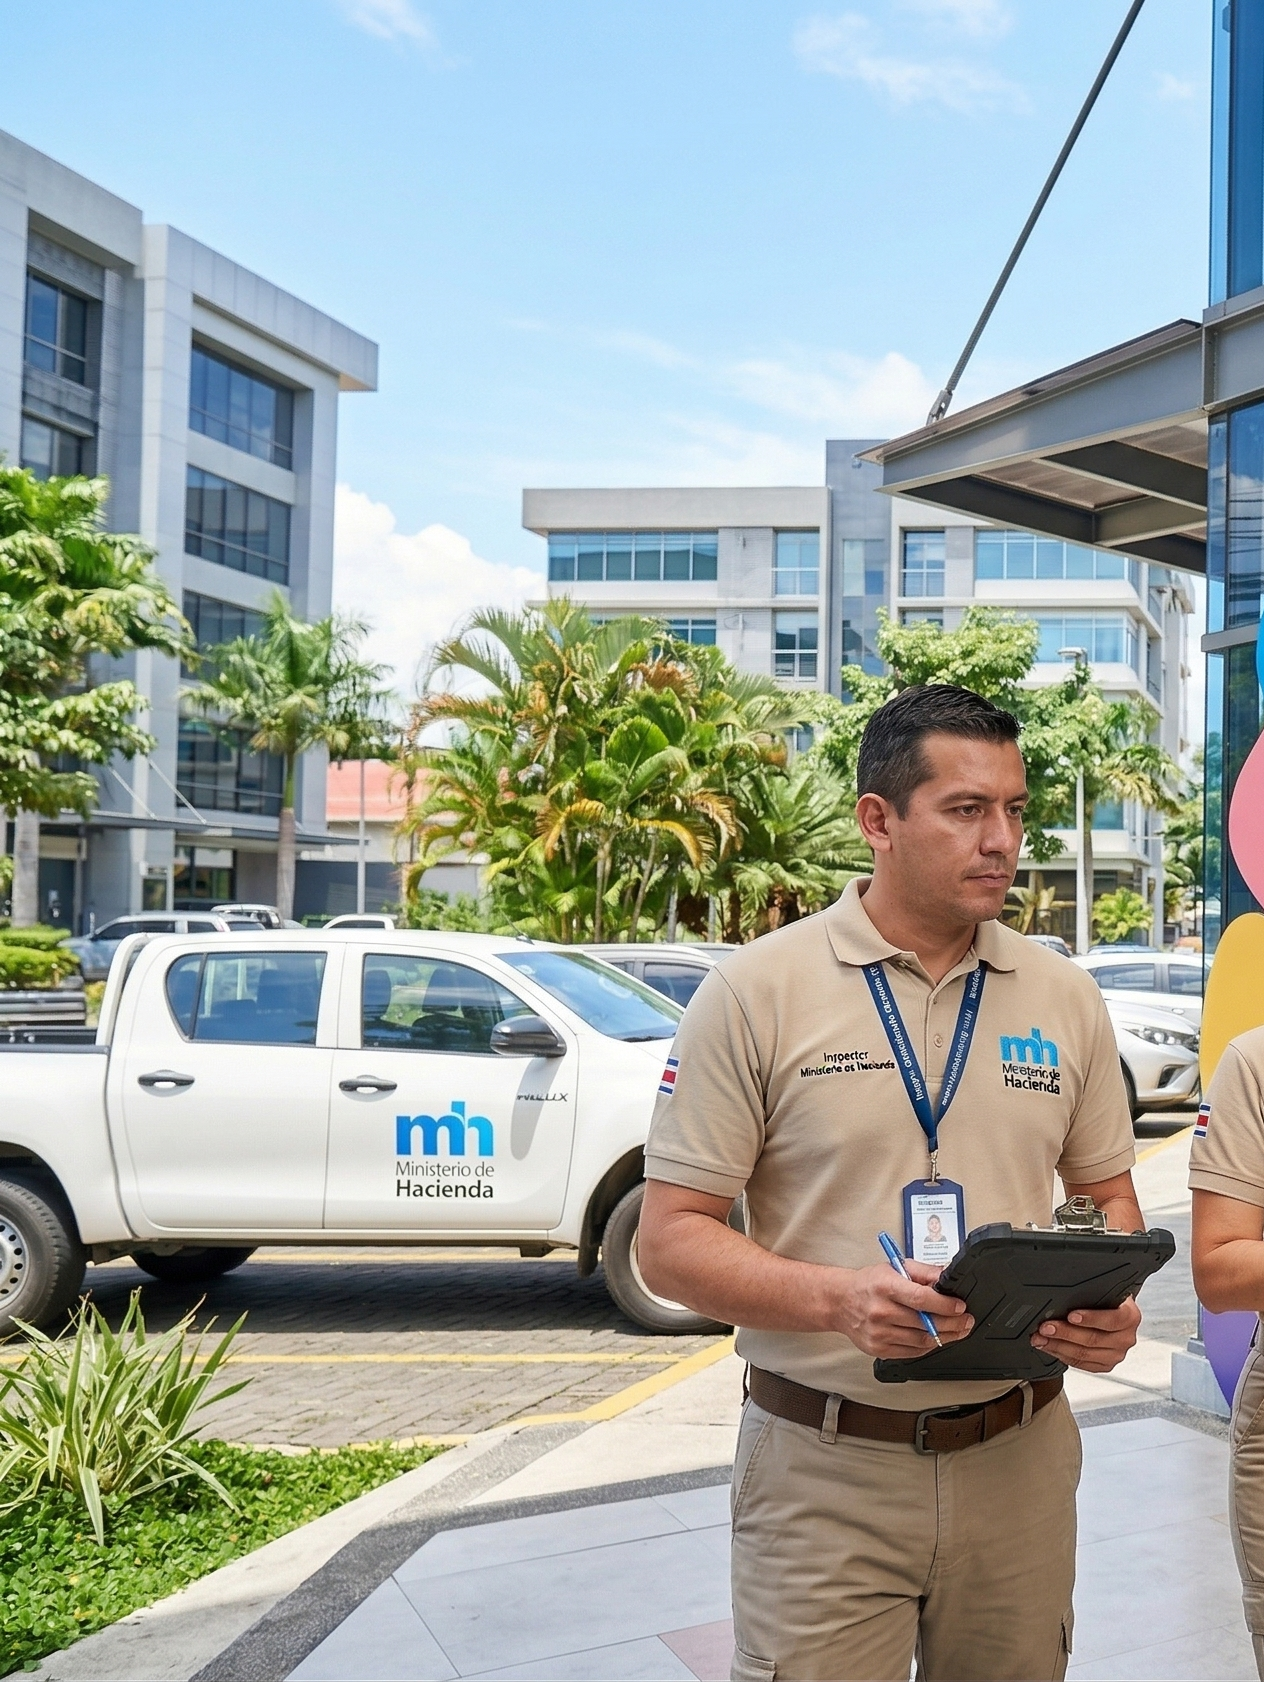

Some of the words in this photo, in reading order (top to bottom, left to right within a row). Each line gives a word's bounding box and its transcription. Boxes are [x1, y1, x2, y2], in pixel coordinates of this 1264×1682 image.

[396, 1161, 471, 1177] Ministerio
[475, 1162, 494, 1177] de
[396, 1179, 494, 1198] Hacienda
